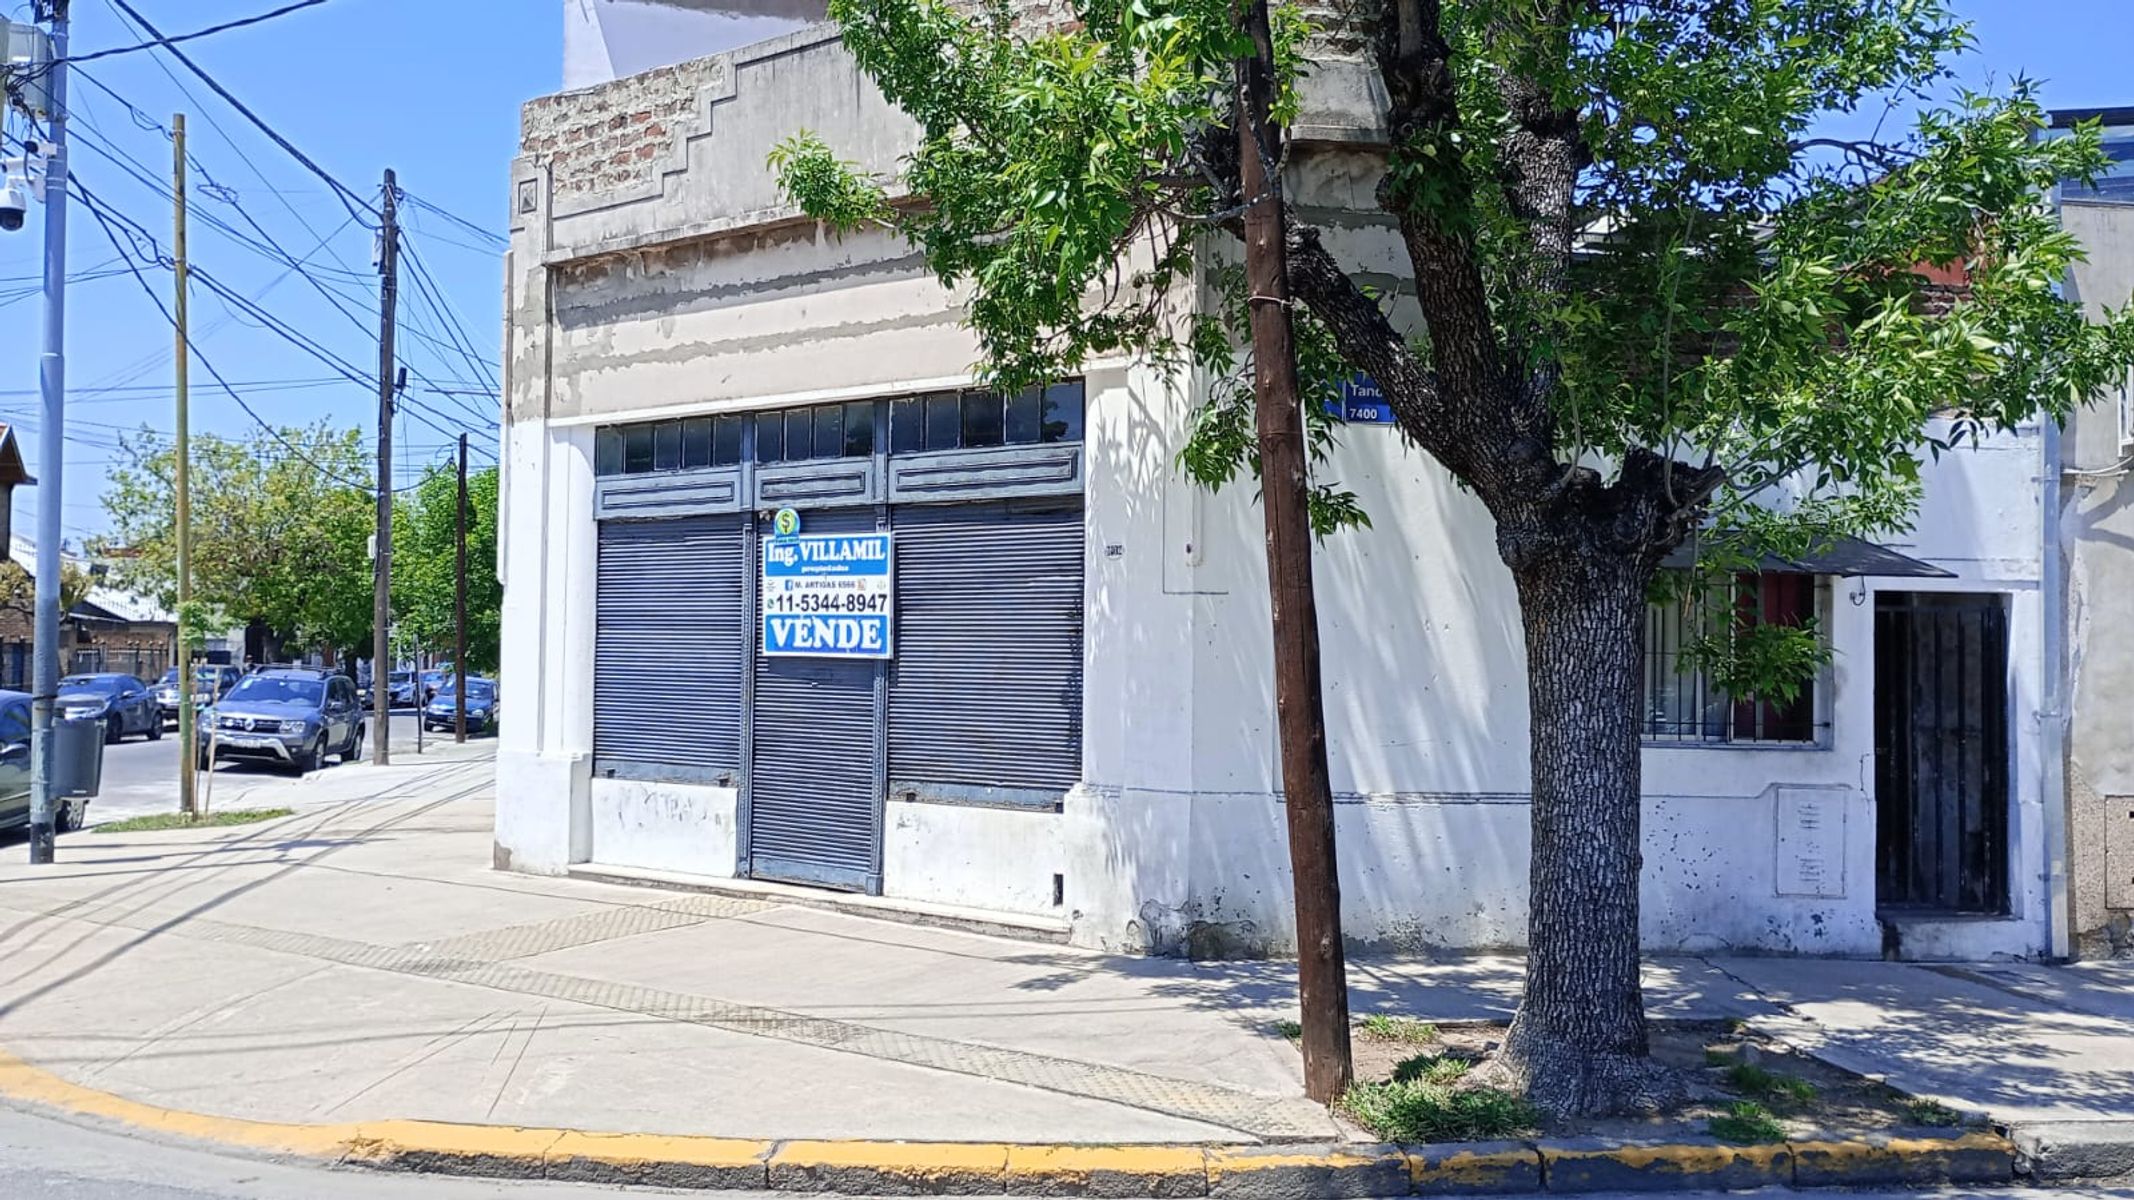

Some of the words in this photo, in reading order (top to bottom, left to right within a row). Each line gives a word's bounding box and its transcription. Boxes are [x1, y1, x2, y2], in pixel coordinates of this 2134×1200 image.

[1349, 408, 1378, 420] 7400
[767, 542, 798, 567] Ing.
[800, 540, 886, 561] VILLAMIL
[804, 580, 836, 589] ARTIGAS
[776, 593, 888, 612] 11-5344-8947
[770, 618, 882, 649] VENDE
